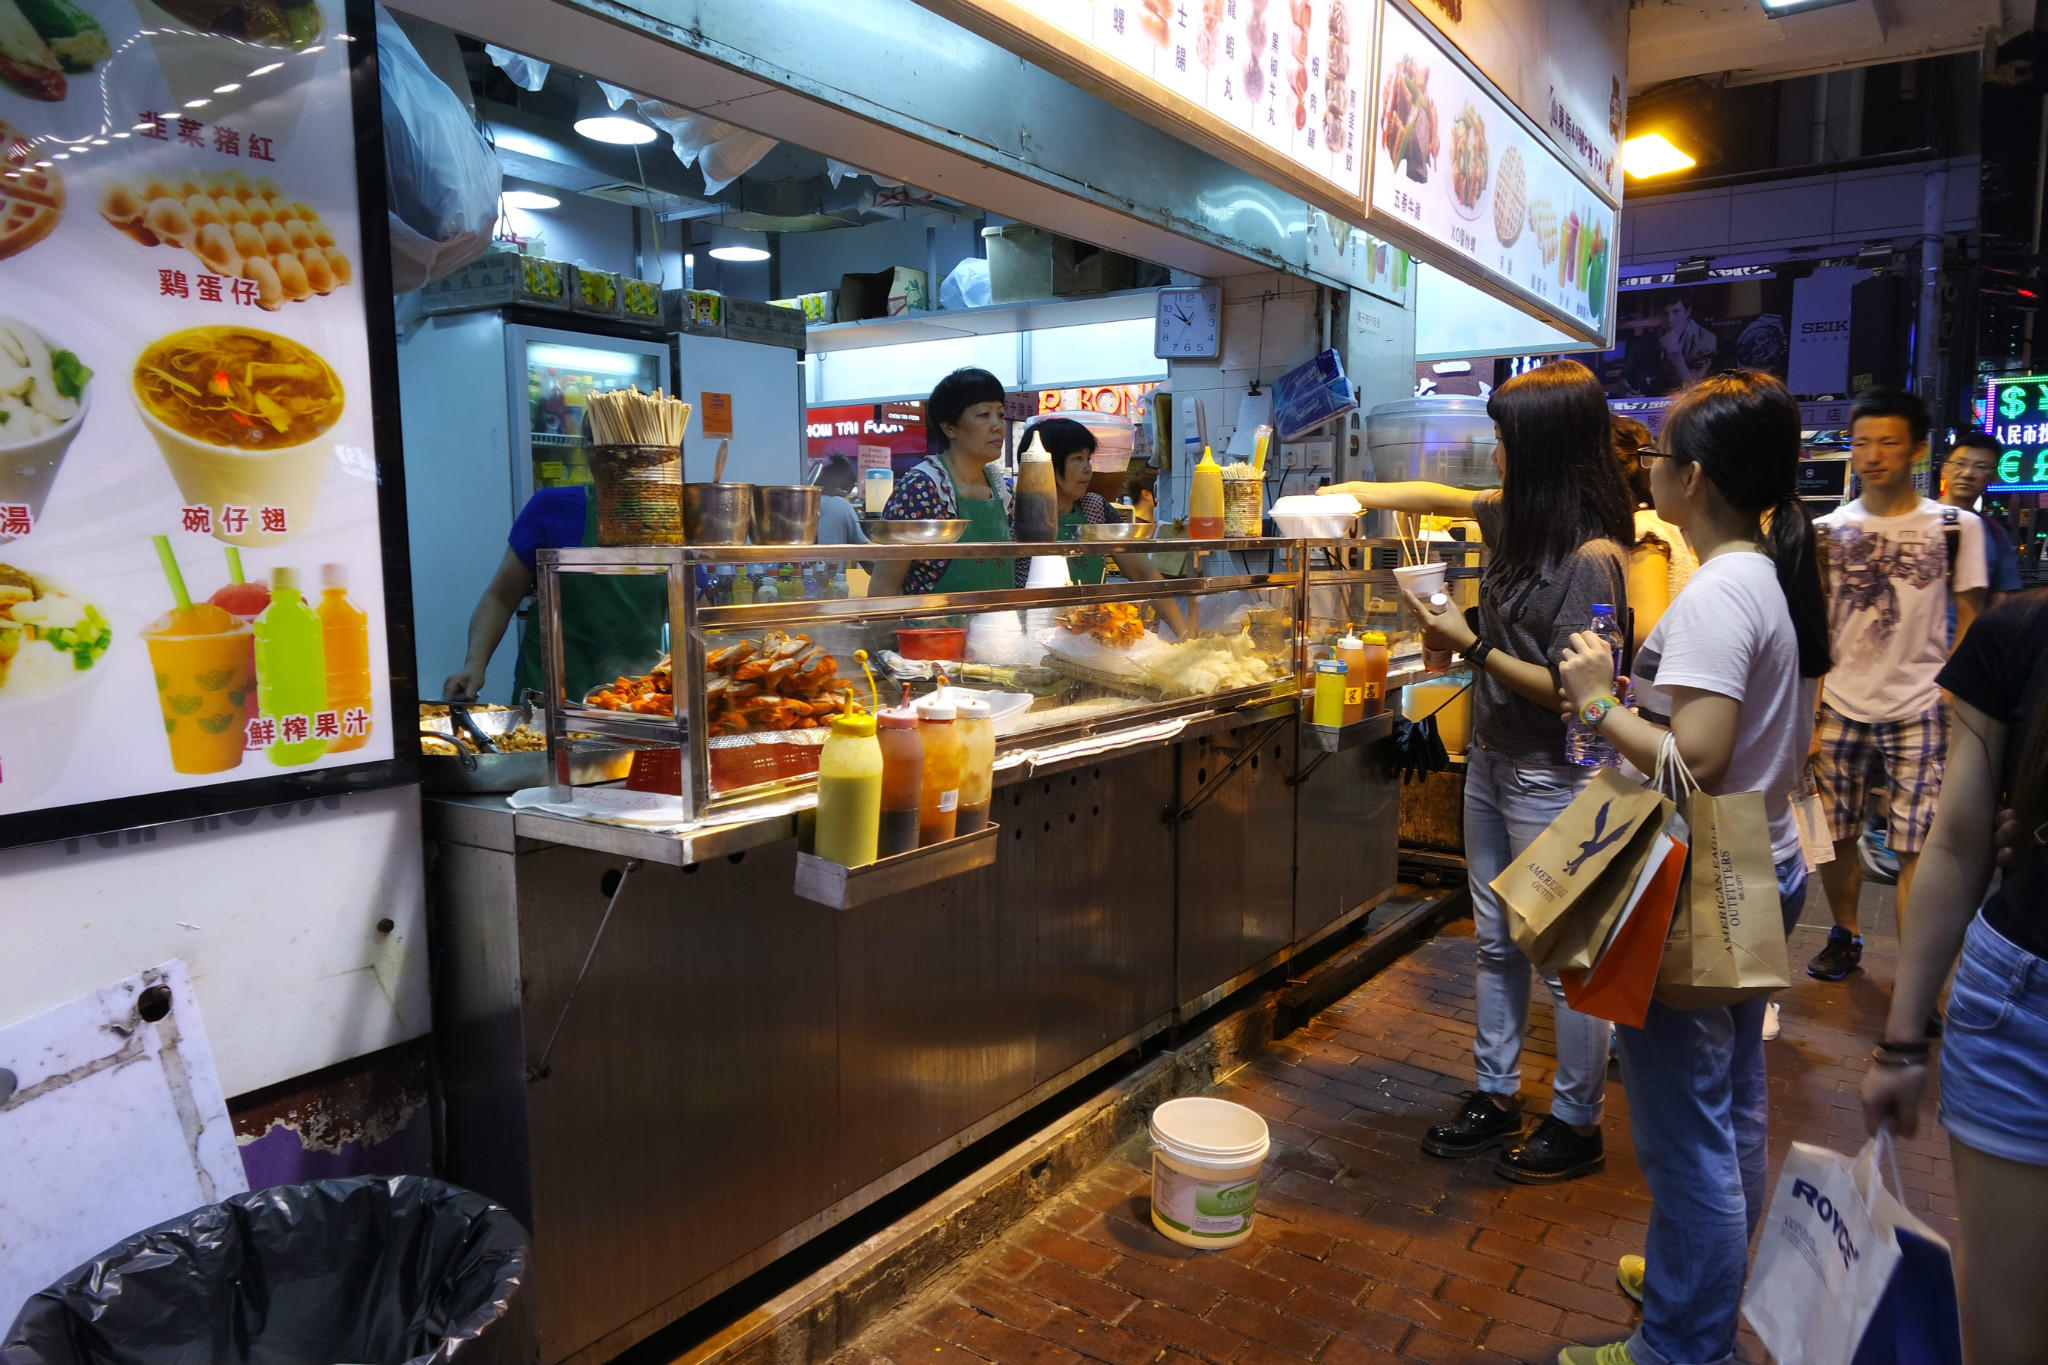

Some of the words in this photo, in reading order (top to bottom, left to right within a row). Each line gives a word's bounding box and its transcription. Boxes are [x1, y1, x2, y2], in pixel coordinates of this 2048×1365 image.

[1186, 294, 1195, 303] 12
[1163, 304, 1173, 313] 10
[1208, 303, 1217, 313] 2
[1163, 319, 1170, 328] 9
[1208, 319, 1215, 328] 3
[1163, 333, 1169, 342] 8
[1208, 333, 1215, 342] 4
[1172, 343, 1179, 352] 7
[1184, 343, 1191, 352] 6
[1197, 343, 1204, 352] 5
[835, 421, 860, 436] TAI
[182, 506, 287, 533] 碗仔翅
[249, 710, 369, 745] 鮮榨果汁
[1720, 850, 1741, 927] OUTFITTERS
